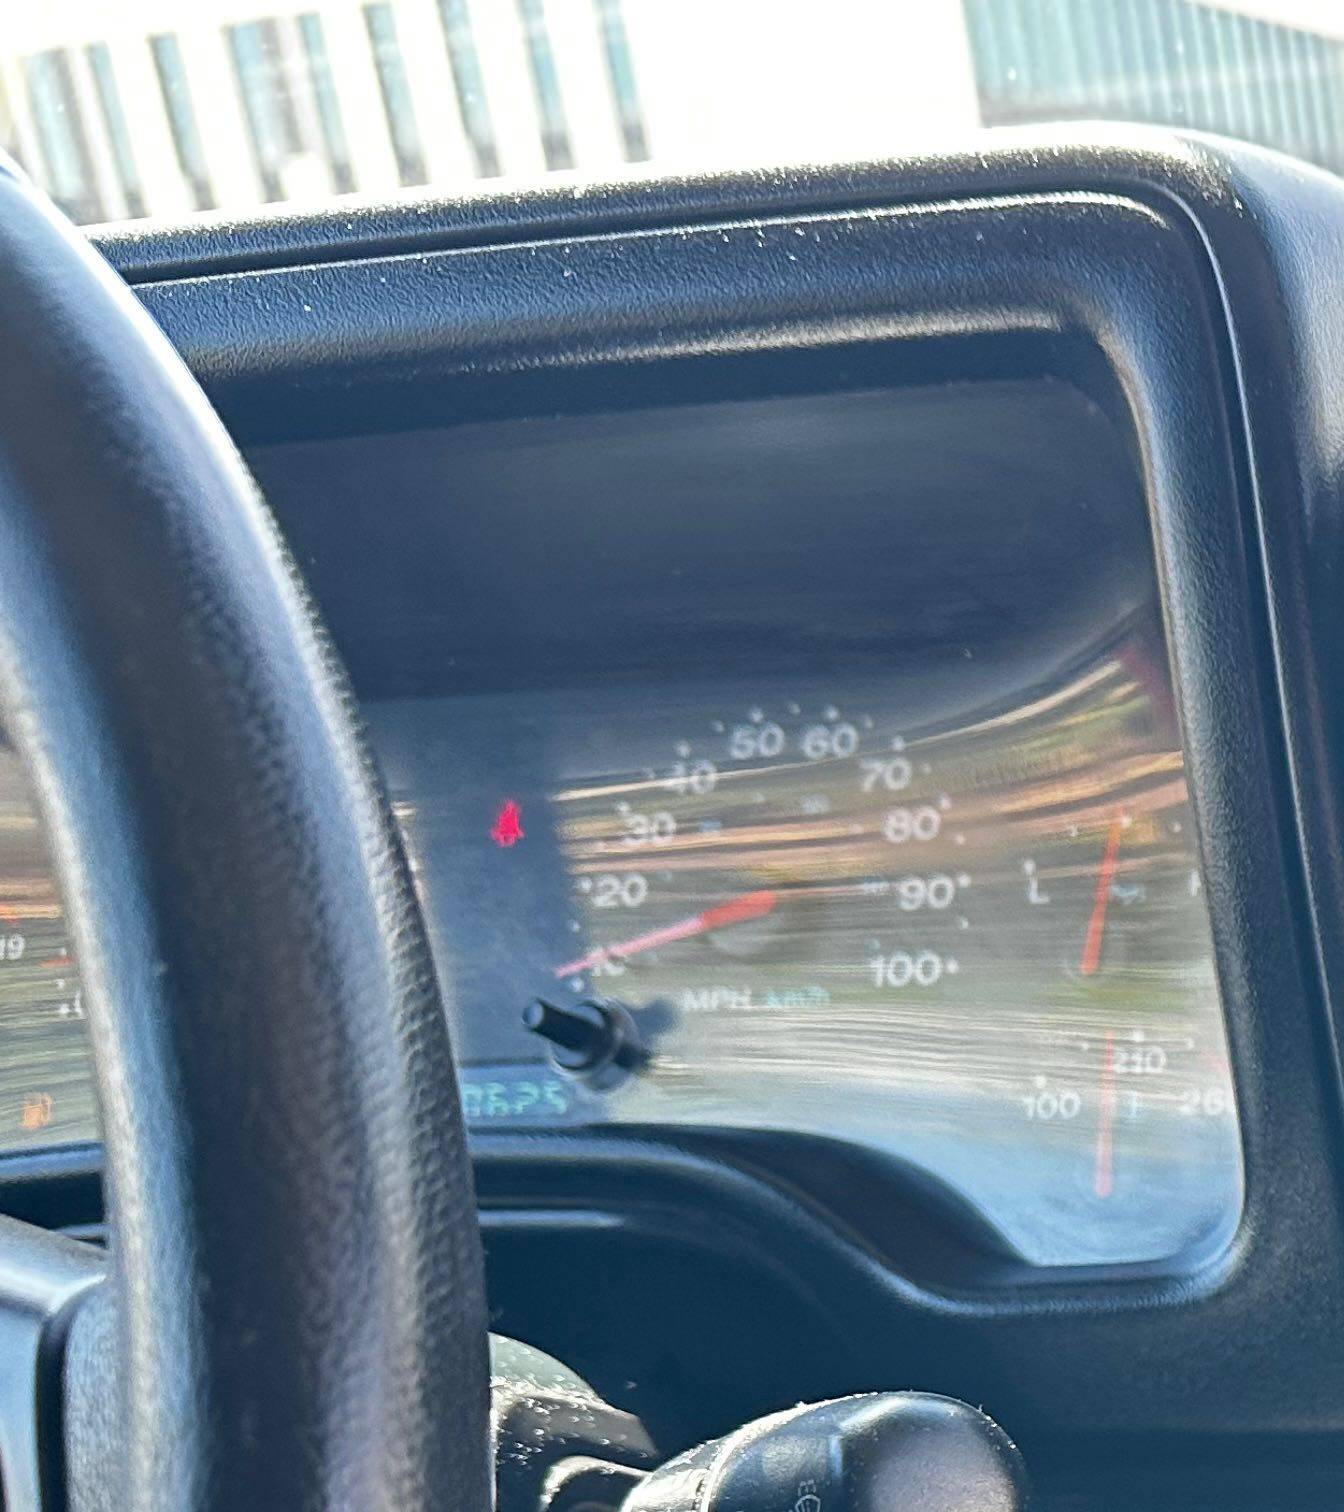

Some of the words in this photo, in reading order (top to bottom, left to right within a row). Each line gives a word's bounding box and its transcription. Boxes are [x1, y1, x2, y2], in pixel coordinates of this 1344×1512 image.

[730, 722, 786, 760] 50
[802, 722, 859, 760] 60
[858, 757, 913, 793] 70
[883, 806, 941, 843] 80
[591, 873, 649, 909] 20
[899, 875, 955, 911] 90
[870, 949, 943, 989] 100
